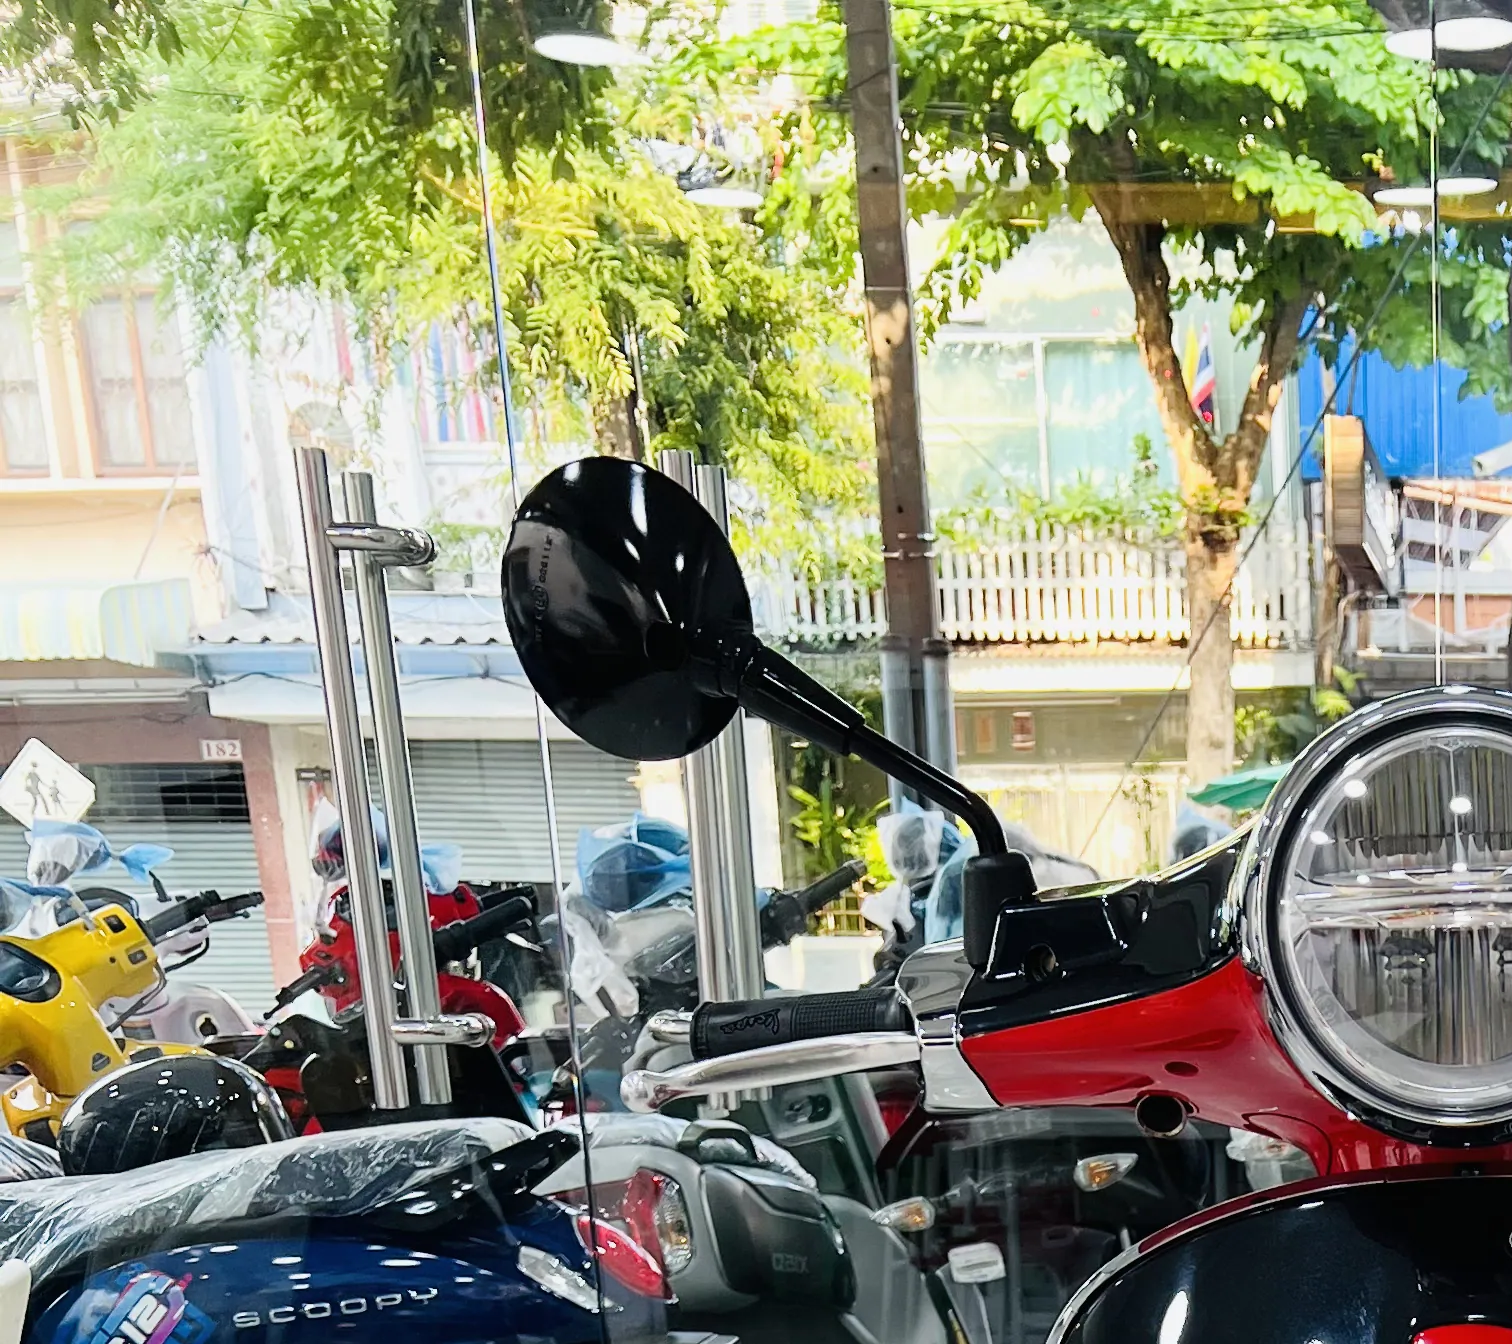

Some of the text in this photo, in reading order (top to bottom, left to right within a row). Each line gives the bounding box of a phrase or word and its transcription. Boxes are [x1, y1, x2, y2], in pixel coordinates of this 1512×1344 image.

[205, 742, 238, 757] 182
[720, 1008, 781, 1036] Vespa
[232, 1287, 438, 1328] SCOOPY
